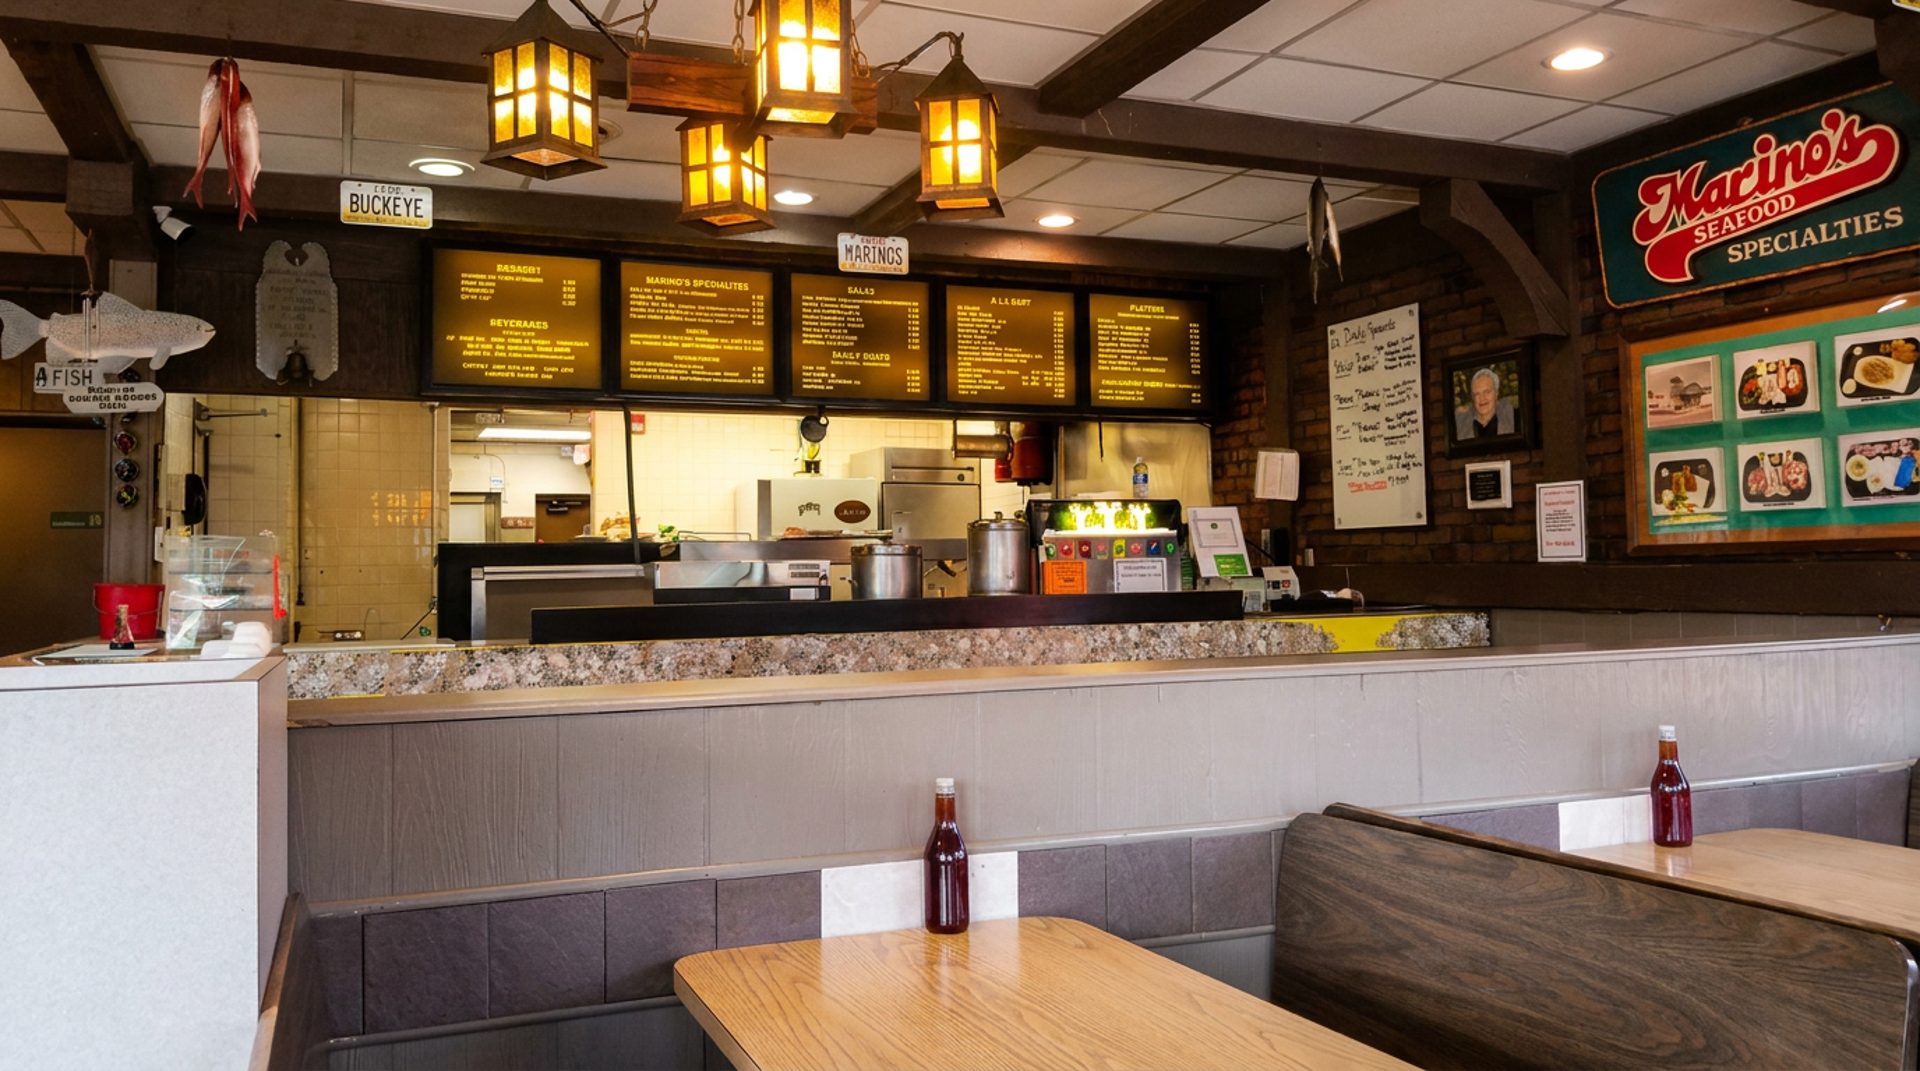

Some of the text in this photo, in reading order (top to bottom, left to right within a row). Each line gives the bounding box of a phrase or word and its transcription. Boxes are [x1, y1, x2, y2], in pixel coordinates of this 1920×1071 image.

[1633, 109, 1899, 245] Marino's
[349, 193, 424, 218] BUCKEYE
[1693, 194, 1796, 244] SEAFOOD
[1727, 206, 1904, 263] SPECIALTIES
[53, 369, 92, 387] FISH
